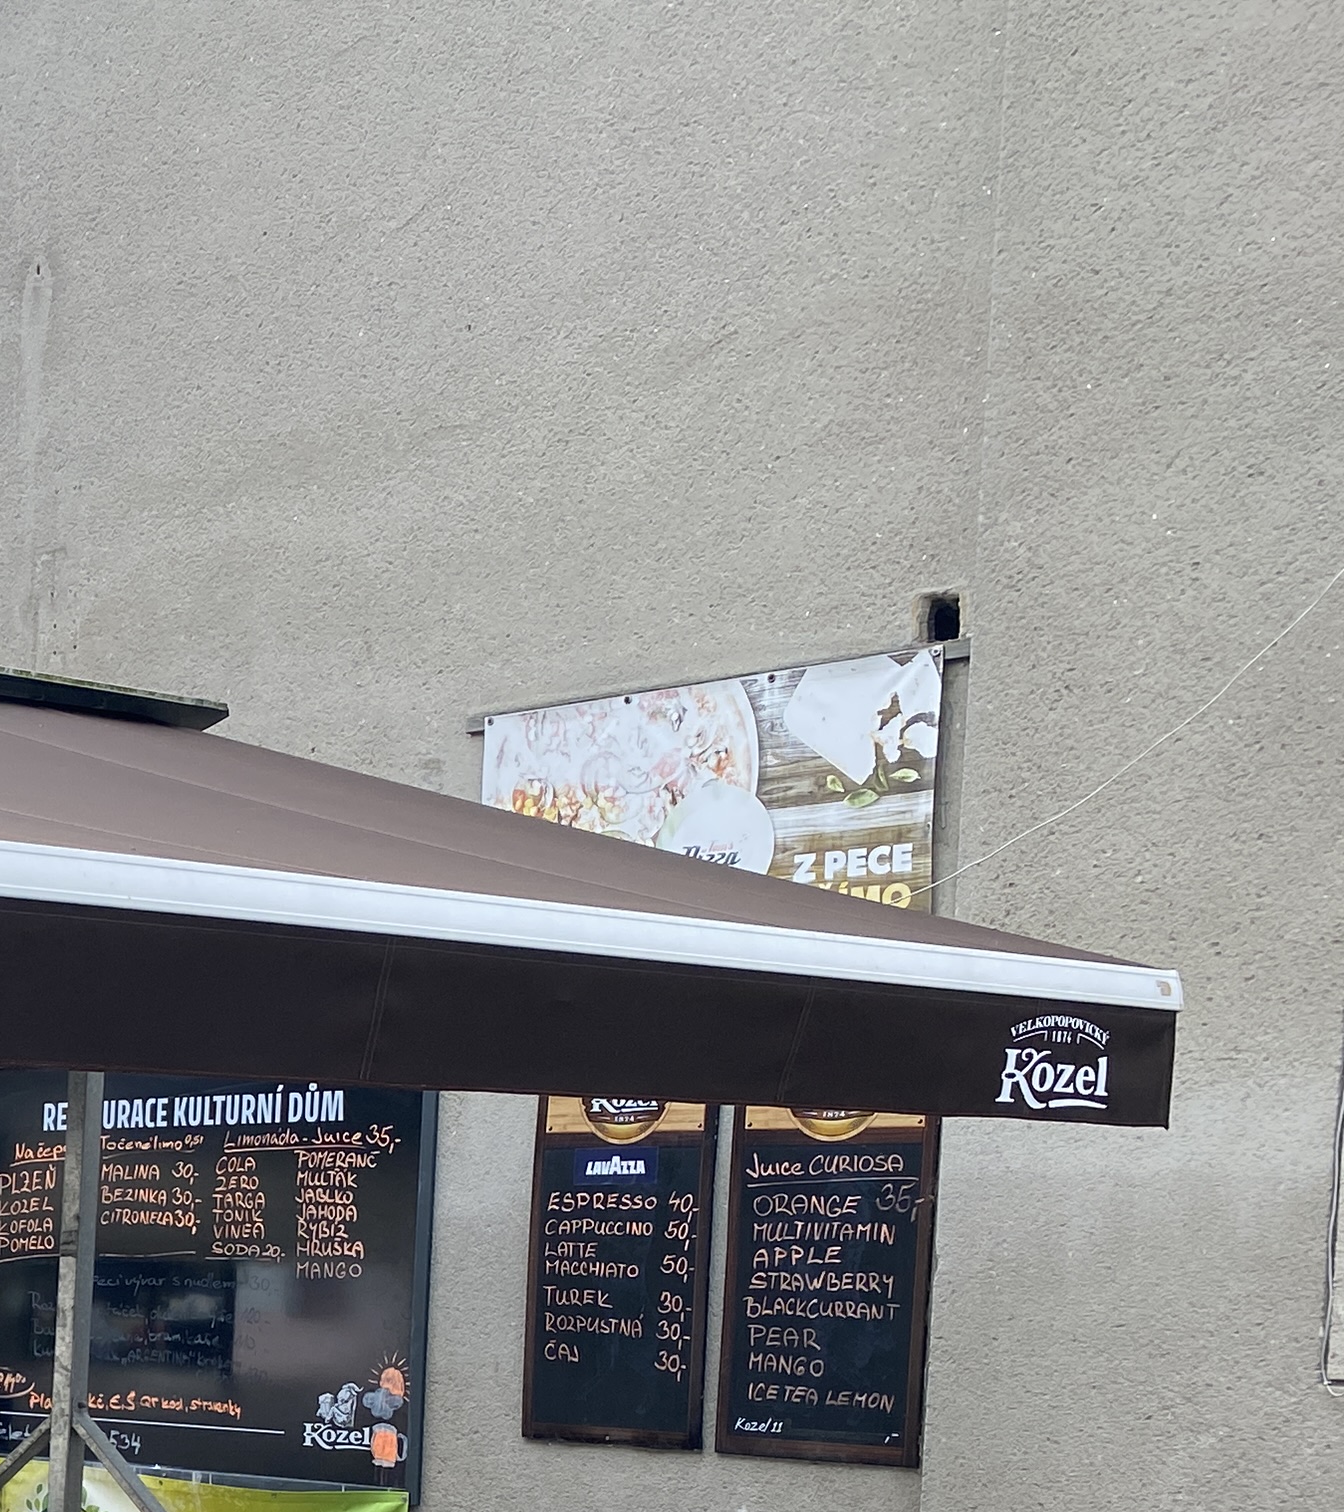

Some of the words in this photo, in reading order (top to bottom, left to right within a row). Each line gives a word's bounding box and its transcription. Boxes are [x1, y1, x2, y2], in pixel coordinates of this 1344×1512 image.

[793, 853, 817, 884] Z
[825, 843, 914, 880] PECE
[1010, 1014, 1111, 1046] VELKOPOPOVICKÝ
[1051, 1030, 1072, 1044] 1874
[995, 1047, 1108, 1109] Kozel
[43, 1097, 169, 1131] REURACE
[173, 1084, 285, 1127] KULTURNÍ
[288, 1082, 344, 1122] DŮM
[224, 1128, 299, 1148] Limonáda
[311, 1127, 363, 1144] Juice
[38, 1142, 67, 1161] čep
[101, 1162, 161, 1182] MALINA
[215, 1156, 256, 1175] COLA
[585, 1155, 646, 1175] LAVAZZA
[746, 1152, 805, 1178] Juice
[809, 1154, 904, 1176] CURIOSA
[215, 1175, 259, 1191] ZERO
[101, 1185, 167, 1206] BEZINKA
[212, 1192, 265, 1209] TARGA
[295, 1188, 353, 1204] JABLKO
[547, 1191, 657, 1212] ESPRESSO
[753, 1193, 861, 1218] ORANGE
[212, 1208, 264, 1222] TONIK
[295, 1204, 357, 1222] JAHODA
[544, 1218, 653, 1236] CAPPUCCINO
[753, 1220, 896, 1245] MULTIVITAMIN
[211, 1241, 260, 1256] SODA
[296, 1238, 364, 1259] HRUŠKA
[544, 1241, 599, 1257] LATTE
[753, 1246, 842, 1269] APPLE
[295, 1262, 362, 1279] MANGO
[545, 1260, 639, 1279] MACCHIATO
[749, 1271, 895, 1299] STRAWBERRY
[543, 1285, 613, 1308] TUREK
[743, 1295, 901, 1321] BLACKCURRANT
[544, 1312, 644, 1338] ROZPUSTNÁ
[747, 1324, 821, 1351] PEAR
[544, 1339, 580, 1362] ČAJ
[748, 1351, 825, 1377] MANGO
[748, 1382, 780, 1402] ICE
[784, 1385, 818, 1407] TEA
[825, 1390, 895, 1414] LEMON
[302, 1422, 371, 1450] Kozel
